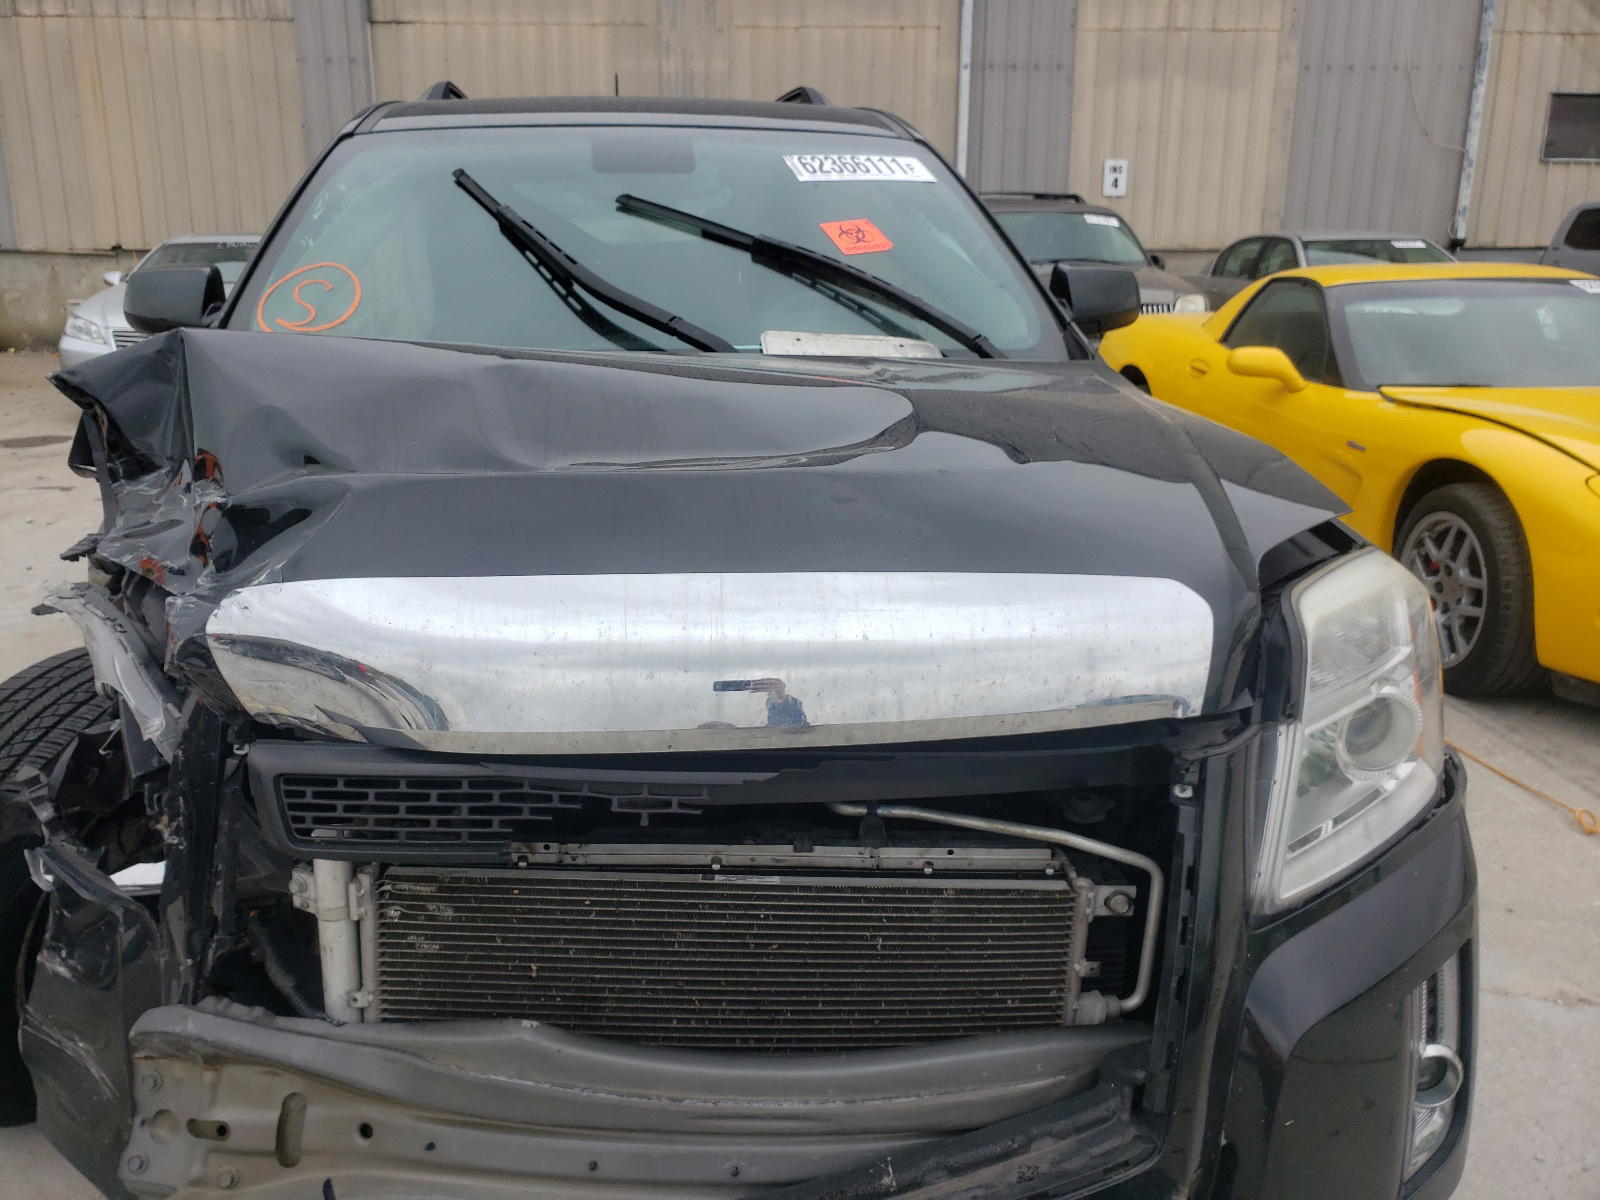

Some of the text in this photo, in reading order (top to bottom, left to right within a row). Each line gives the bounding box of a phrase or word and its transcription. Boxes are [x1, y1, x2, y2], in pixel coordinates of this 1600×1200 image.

[798, 156, 908, 175] 62366111
[1109, 166, 1123, 174] INS
[1111, 177, 1119, 189] 4
